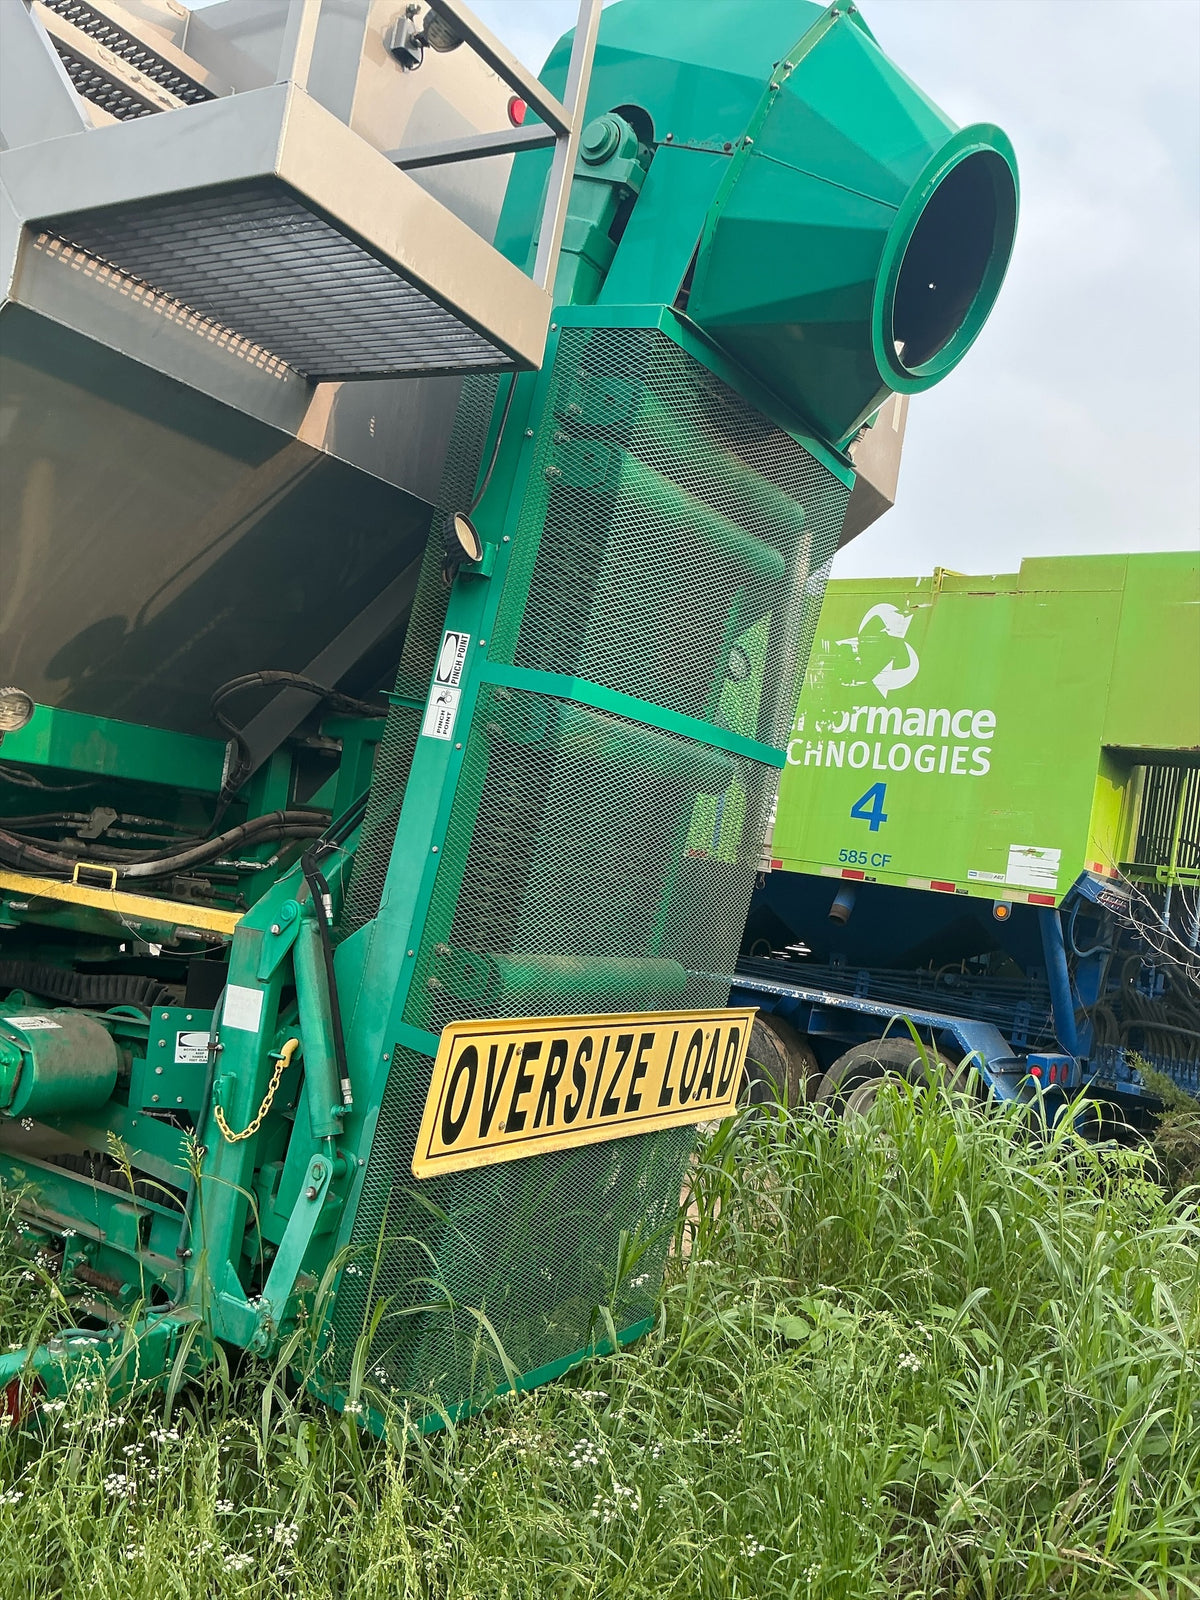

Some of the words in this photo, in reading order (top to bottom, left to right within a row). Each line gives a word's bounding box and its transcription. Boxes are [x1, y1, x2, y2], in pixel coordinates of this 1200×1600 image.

[451, 660, 463, 685] PINCH
[457, 634, 469, 659] POINT
[436, 710, 446, 734] PINCH
[442, 712, 452, 735] POINT
[850, 782, 888, 832] 4
[838, 848, 868, 865] 585
[871, 853, 892, 867] CF
[441, 1032, 656, 1146] OVERSIZE
[657, 1026, 741, 1108] LOAD
